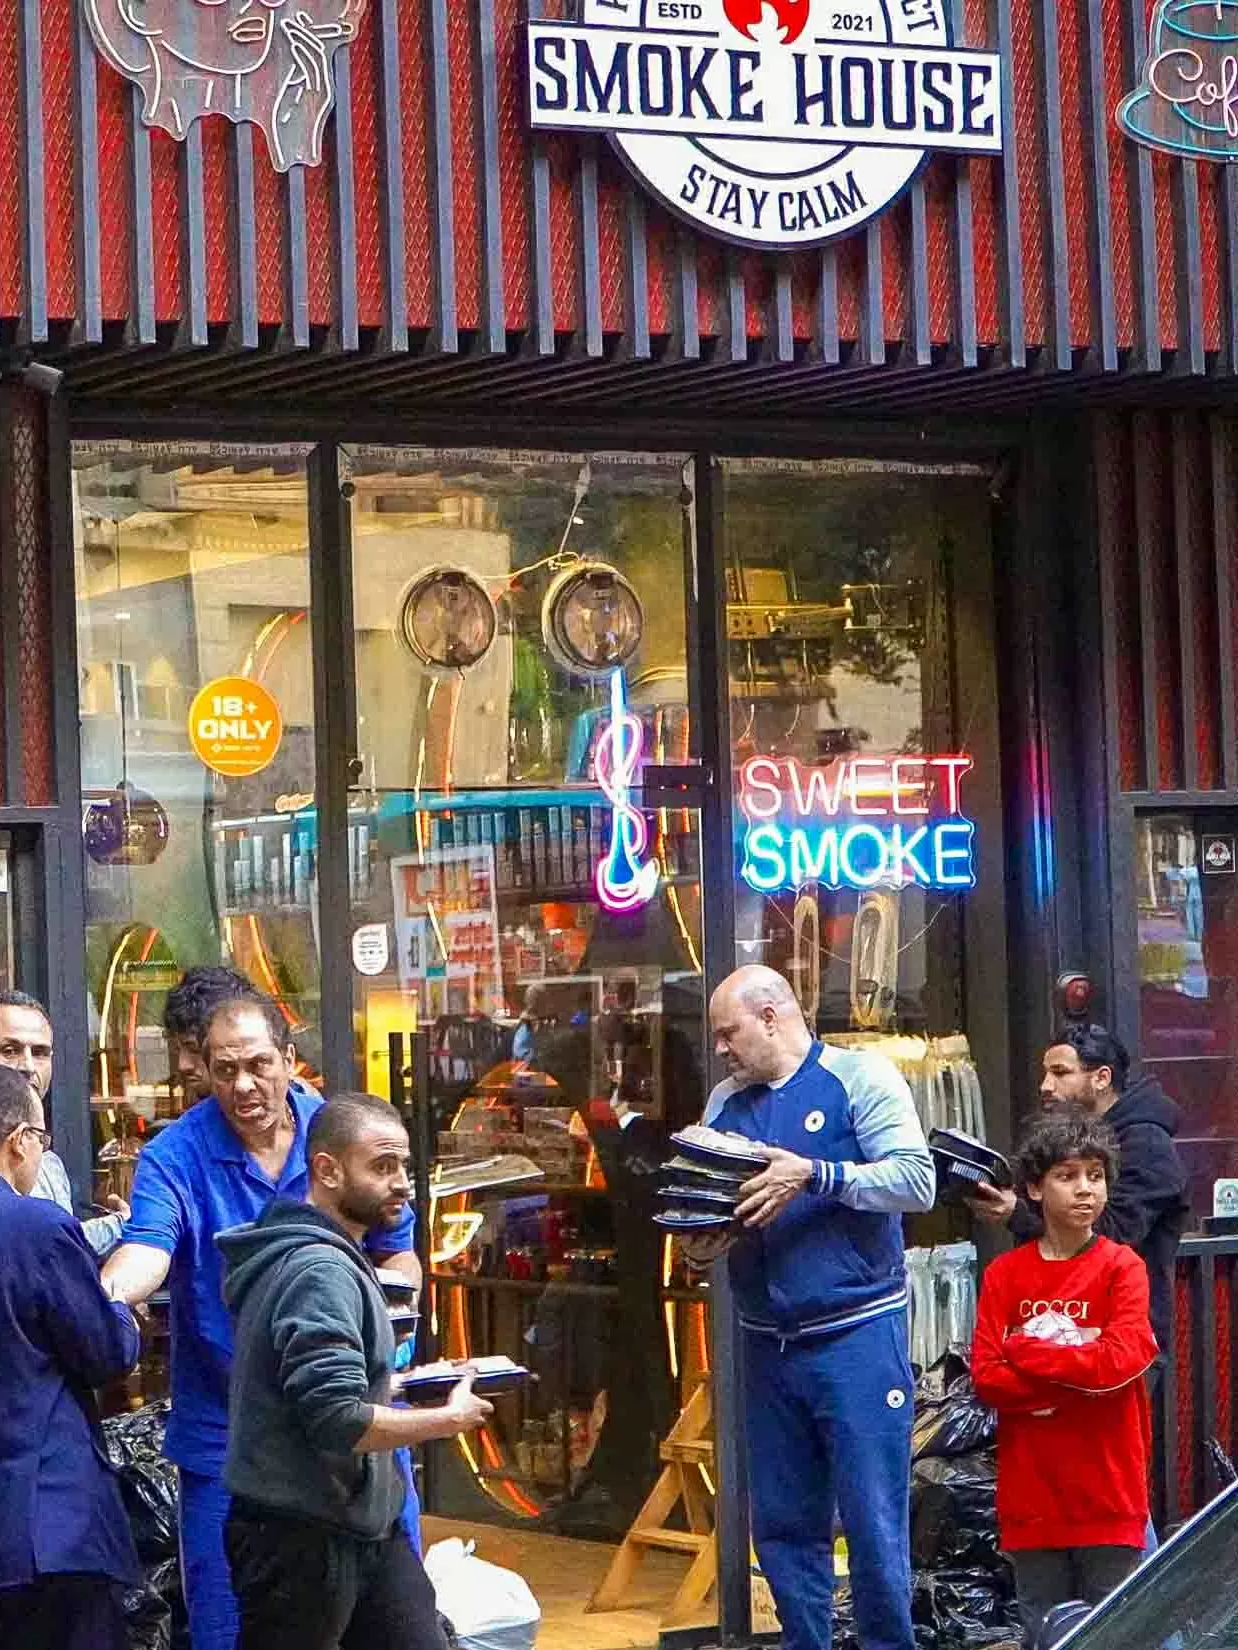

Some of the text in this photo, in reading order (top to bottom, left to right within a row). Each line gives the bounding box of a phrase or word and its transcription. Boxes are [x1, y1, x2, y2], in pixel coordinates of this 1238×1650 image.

[658, 2, 874, 32] ESTD 2021
[535, 37, 995, 137] SMOKE HOUSE
[680, 164, 868, 232] STAY CALM
[198, 719, 273, 740] ONLY
[213, 696, 258, 716] 18+
[745, 759, 970, 817] SWEET
[747, 823, 972, 888] SMOKE
